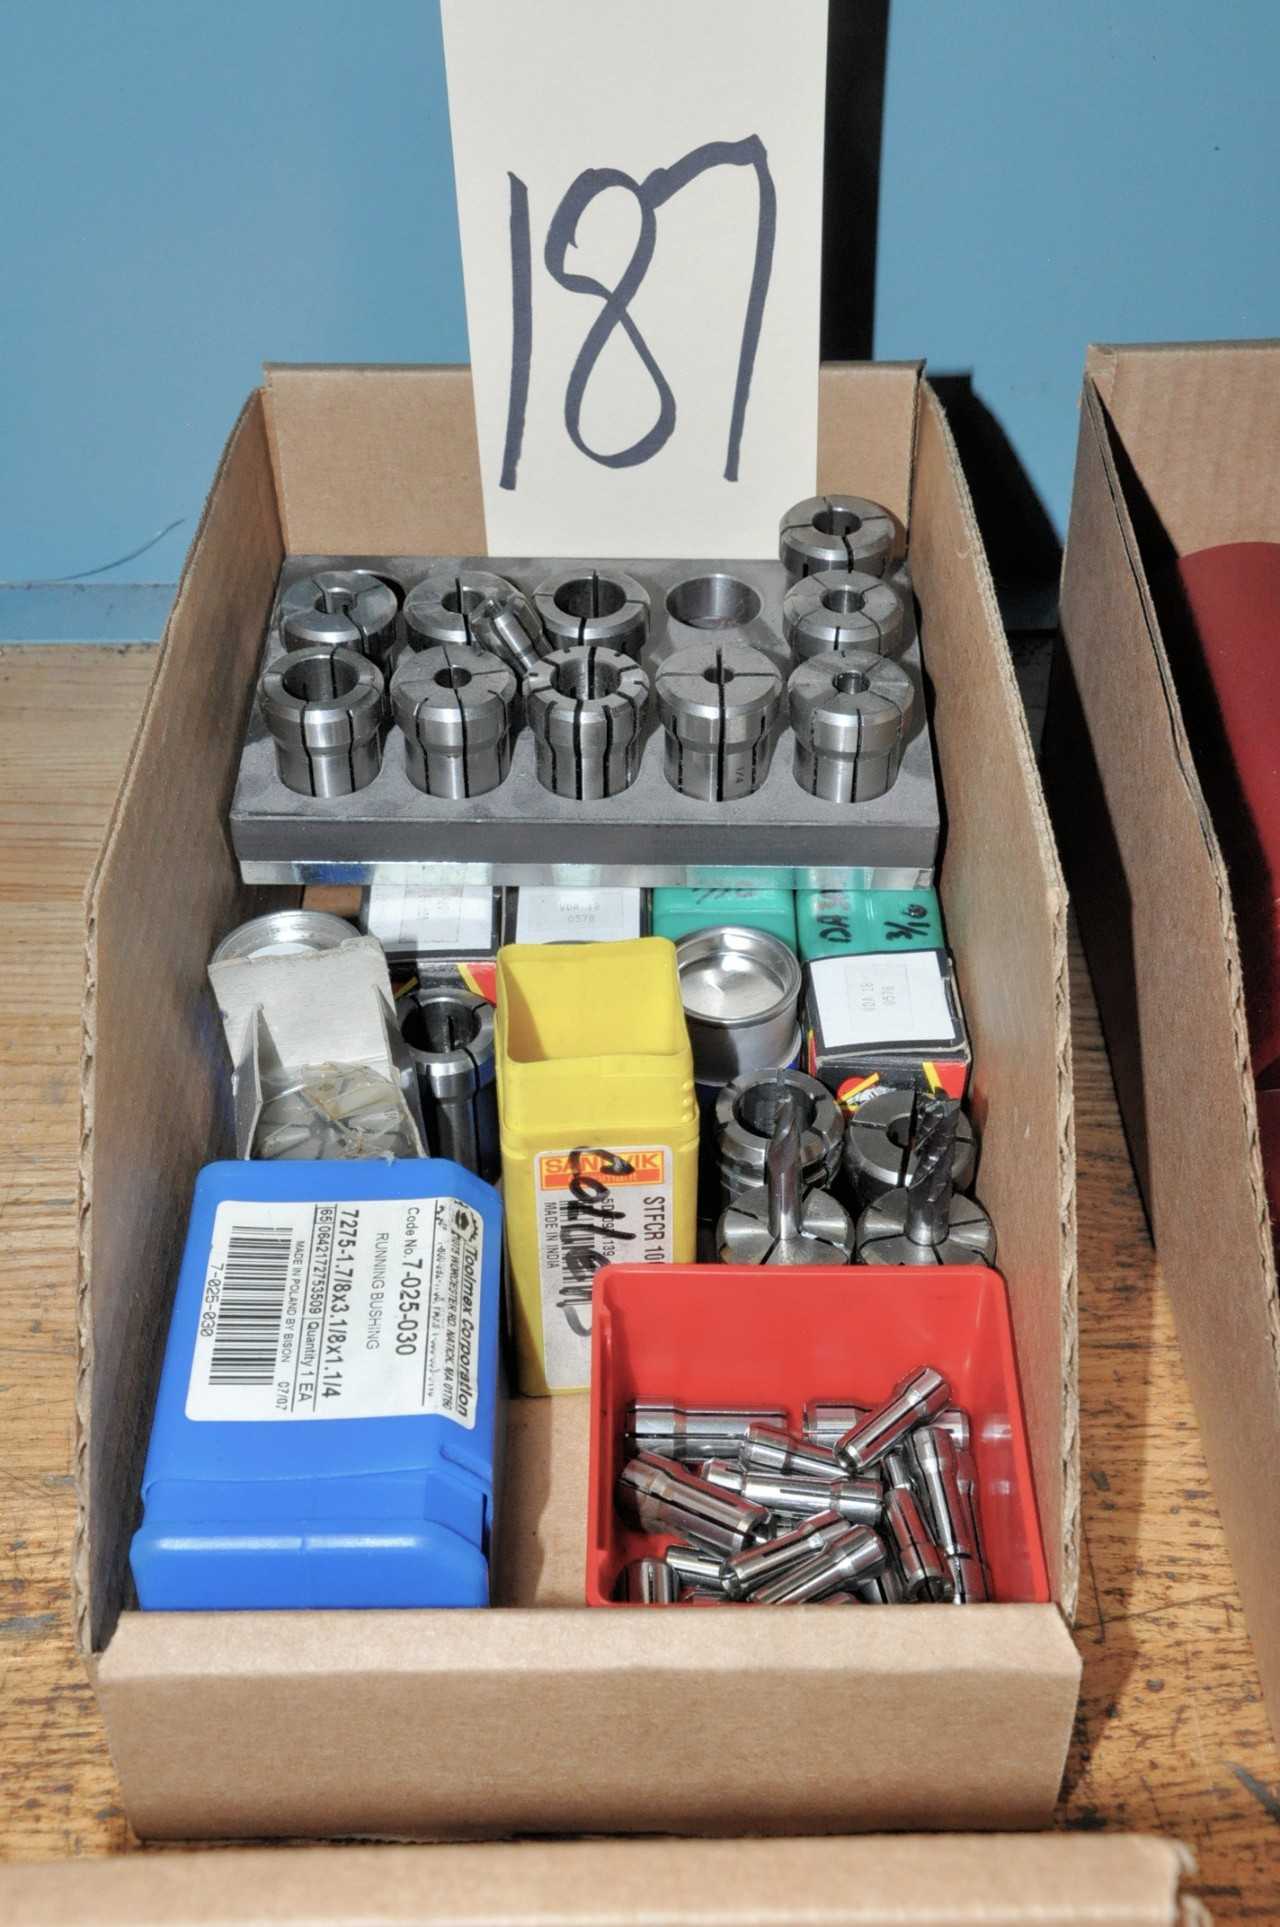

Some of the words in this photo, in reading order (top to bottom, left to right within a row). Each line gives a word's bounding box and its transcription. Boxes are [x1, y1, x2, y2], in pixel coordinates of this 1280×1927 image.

[499, 134, 776, 490] 187
[319, 1209, 332, 1222] 65
[405, 1208, 420, 1236] Code
[544, 1202, 558, 1229] MADE
[643, 1196, 665, 1240] STFCR
[292, 1241, 305, 1265] MADE
[403, 1239, 416, 1258] No.
[546, 1232, 559, 1241] IN
[309, 1226, 331, 1314] 0642172753509
[372, 1232, 389, 1289] RUNNING
[546, 1245, 559, 1268] INDIA
[643, 1246, 665, 1264] 10
[292, 1268, 302, 1276] IN
[462, 1248, 478, 1315] Toolmex
[200, 1263, 224, 1337] 7-025-030
[287, 1279, 300, 1316] POLAND
[322, 1210, 359, 1398] 7275-1.7/8x3.1/8x1.1/4
[396, 1259, 422, 1356] 7-025-030
[284, 1319, 296, 1332] BY
[366, 1292, 384, 1350] BUSHING
[281, 1333, 295, 1362] BISON
[302, 1322, 320, 1366] Quantity
[458, 1318, 474, 1416] Corporation
[298, 1383, 313, 1402] EA
